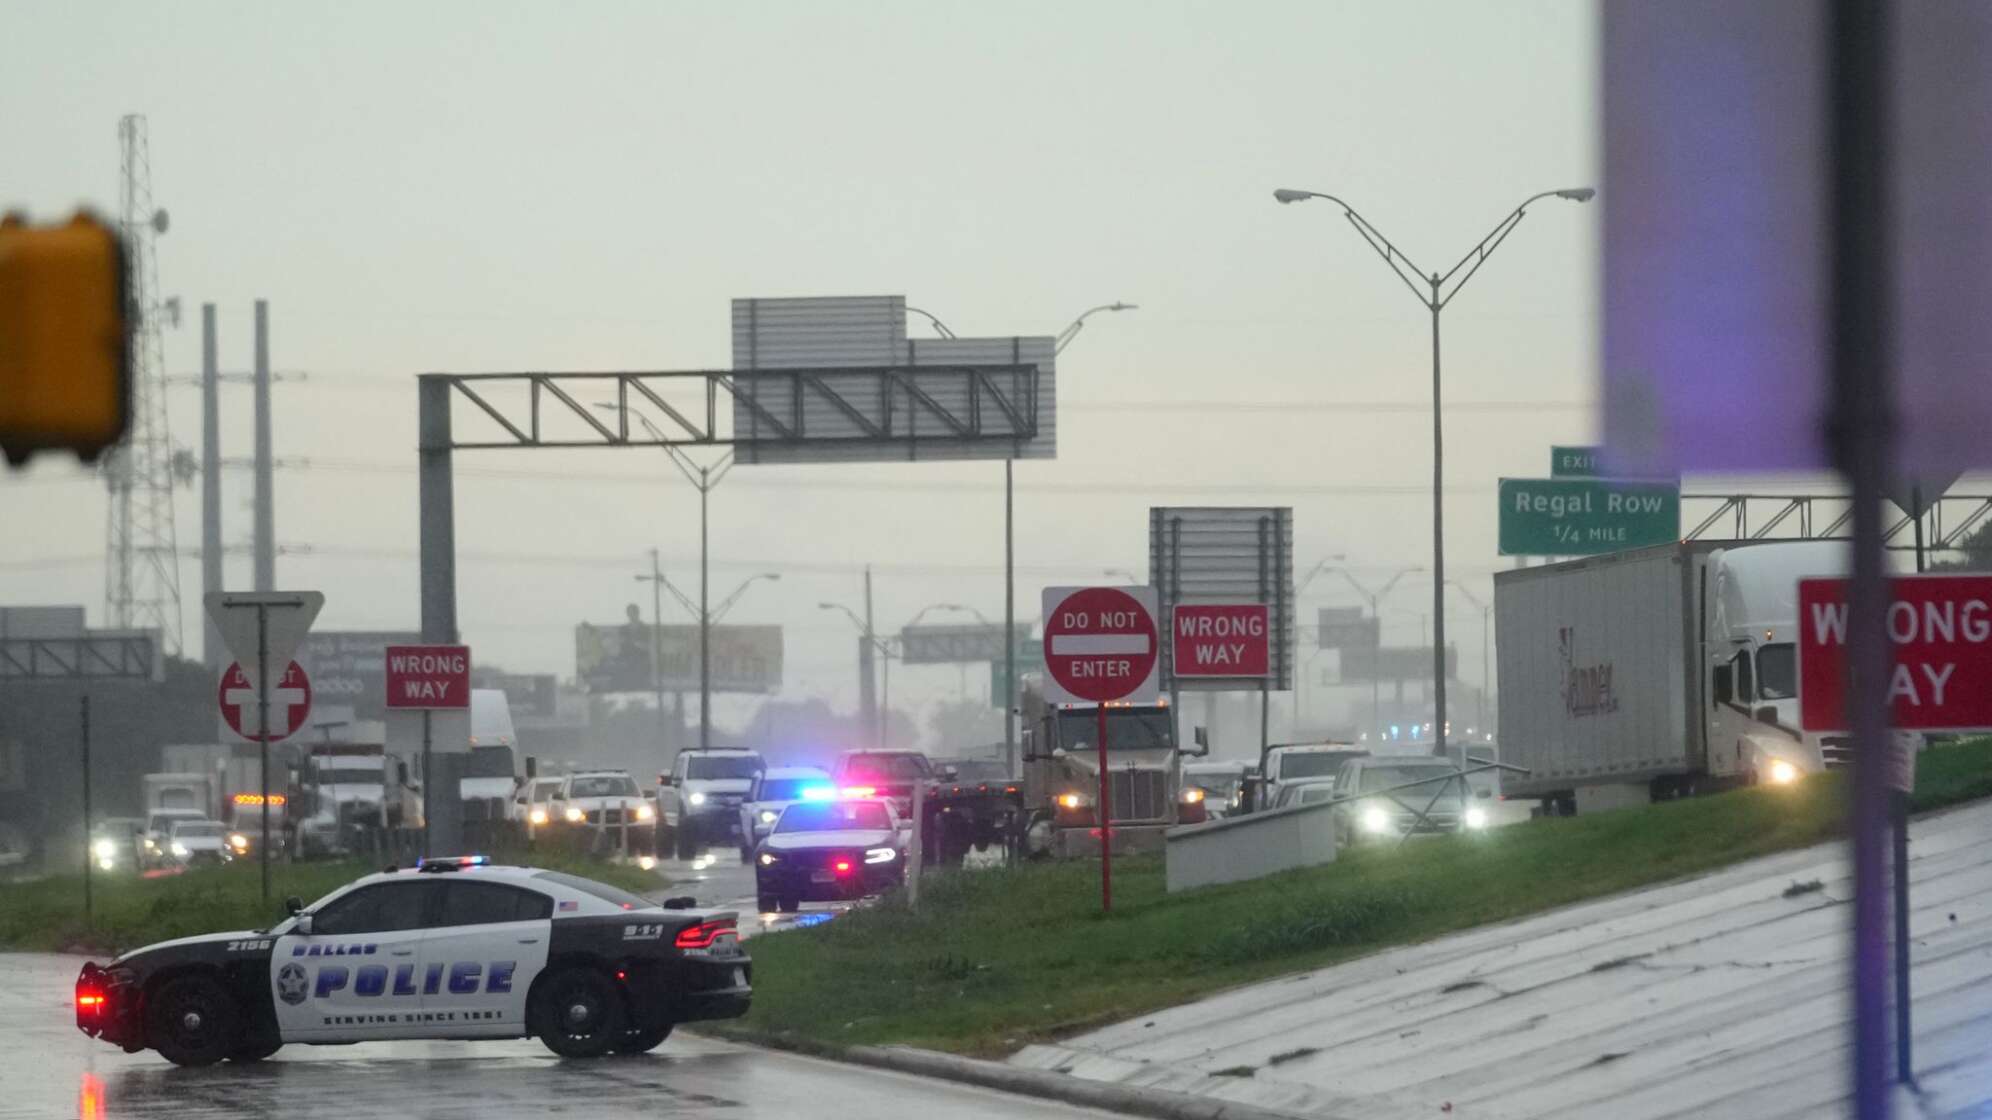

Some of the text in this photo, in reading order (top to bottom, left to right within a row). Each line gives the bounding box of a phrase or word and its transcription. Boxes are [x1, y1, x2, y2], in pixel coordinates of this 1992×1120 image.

[1562, 455, 1595, 469] EXIT
[1515, 491, 1663, 518] Regal Row
[1589, 527, 1627, 541] MILE
[1063, 611, 1137, 629] DO NOT
[1179, 615, 1263, 637] WRONG
[1811, 598, 1992, 645] WONG
[1195, 643, 1246, 665] WAY
[391, 655, 465, 674] WRONG
[1071, 660, 1131, 677] ENTER
[404, 680, 451, 699] WAY
[1866, 663, 1956, 707] AY
[227, 940, 272, 952] 2156
[292, 943, 378, 957] DALLAS
[314, 960, 517, 999] POLICE
[323, 1013, 397, 1025] SERVING
[405, 1011, 456, 1023] SINCE
